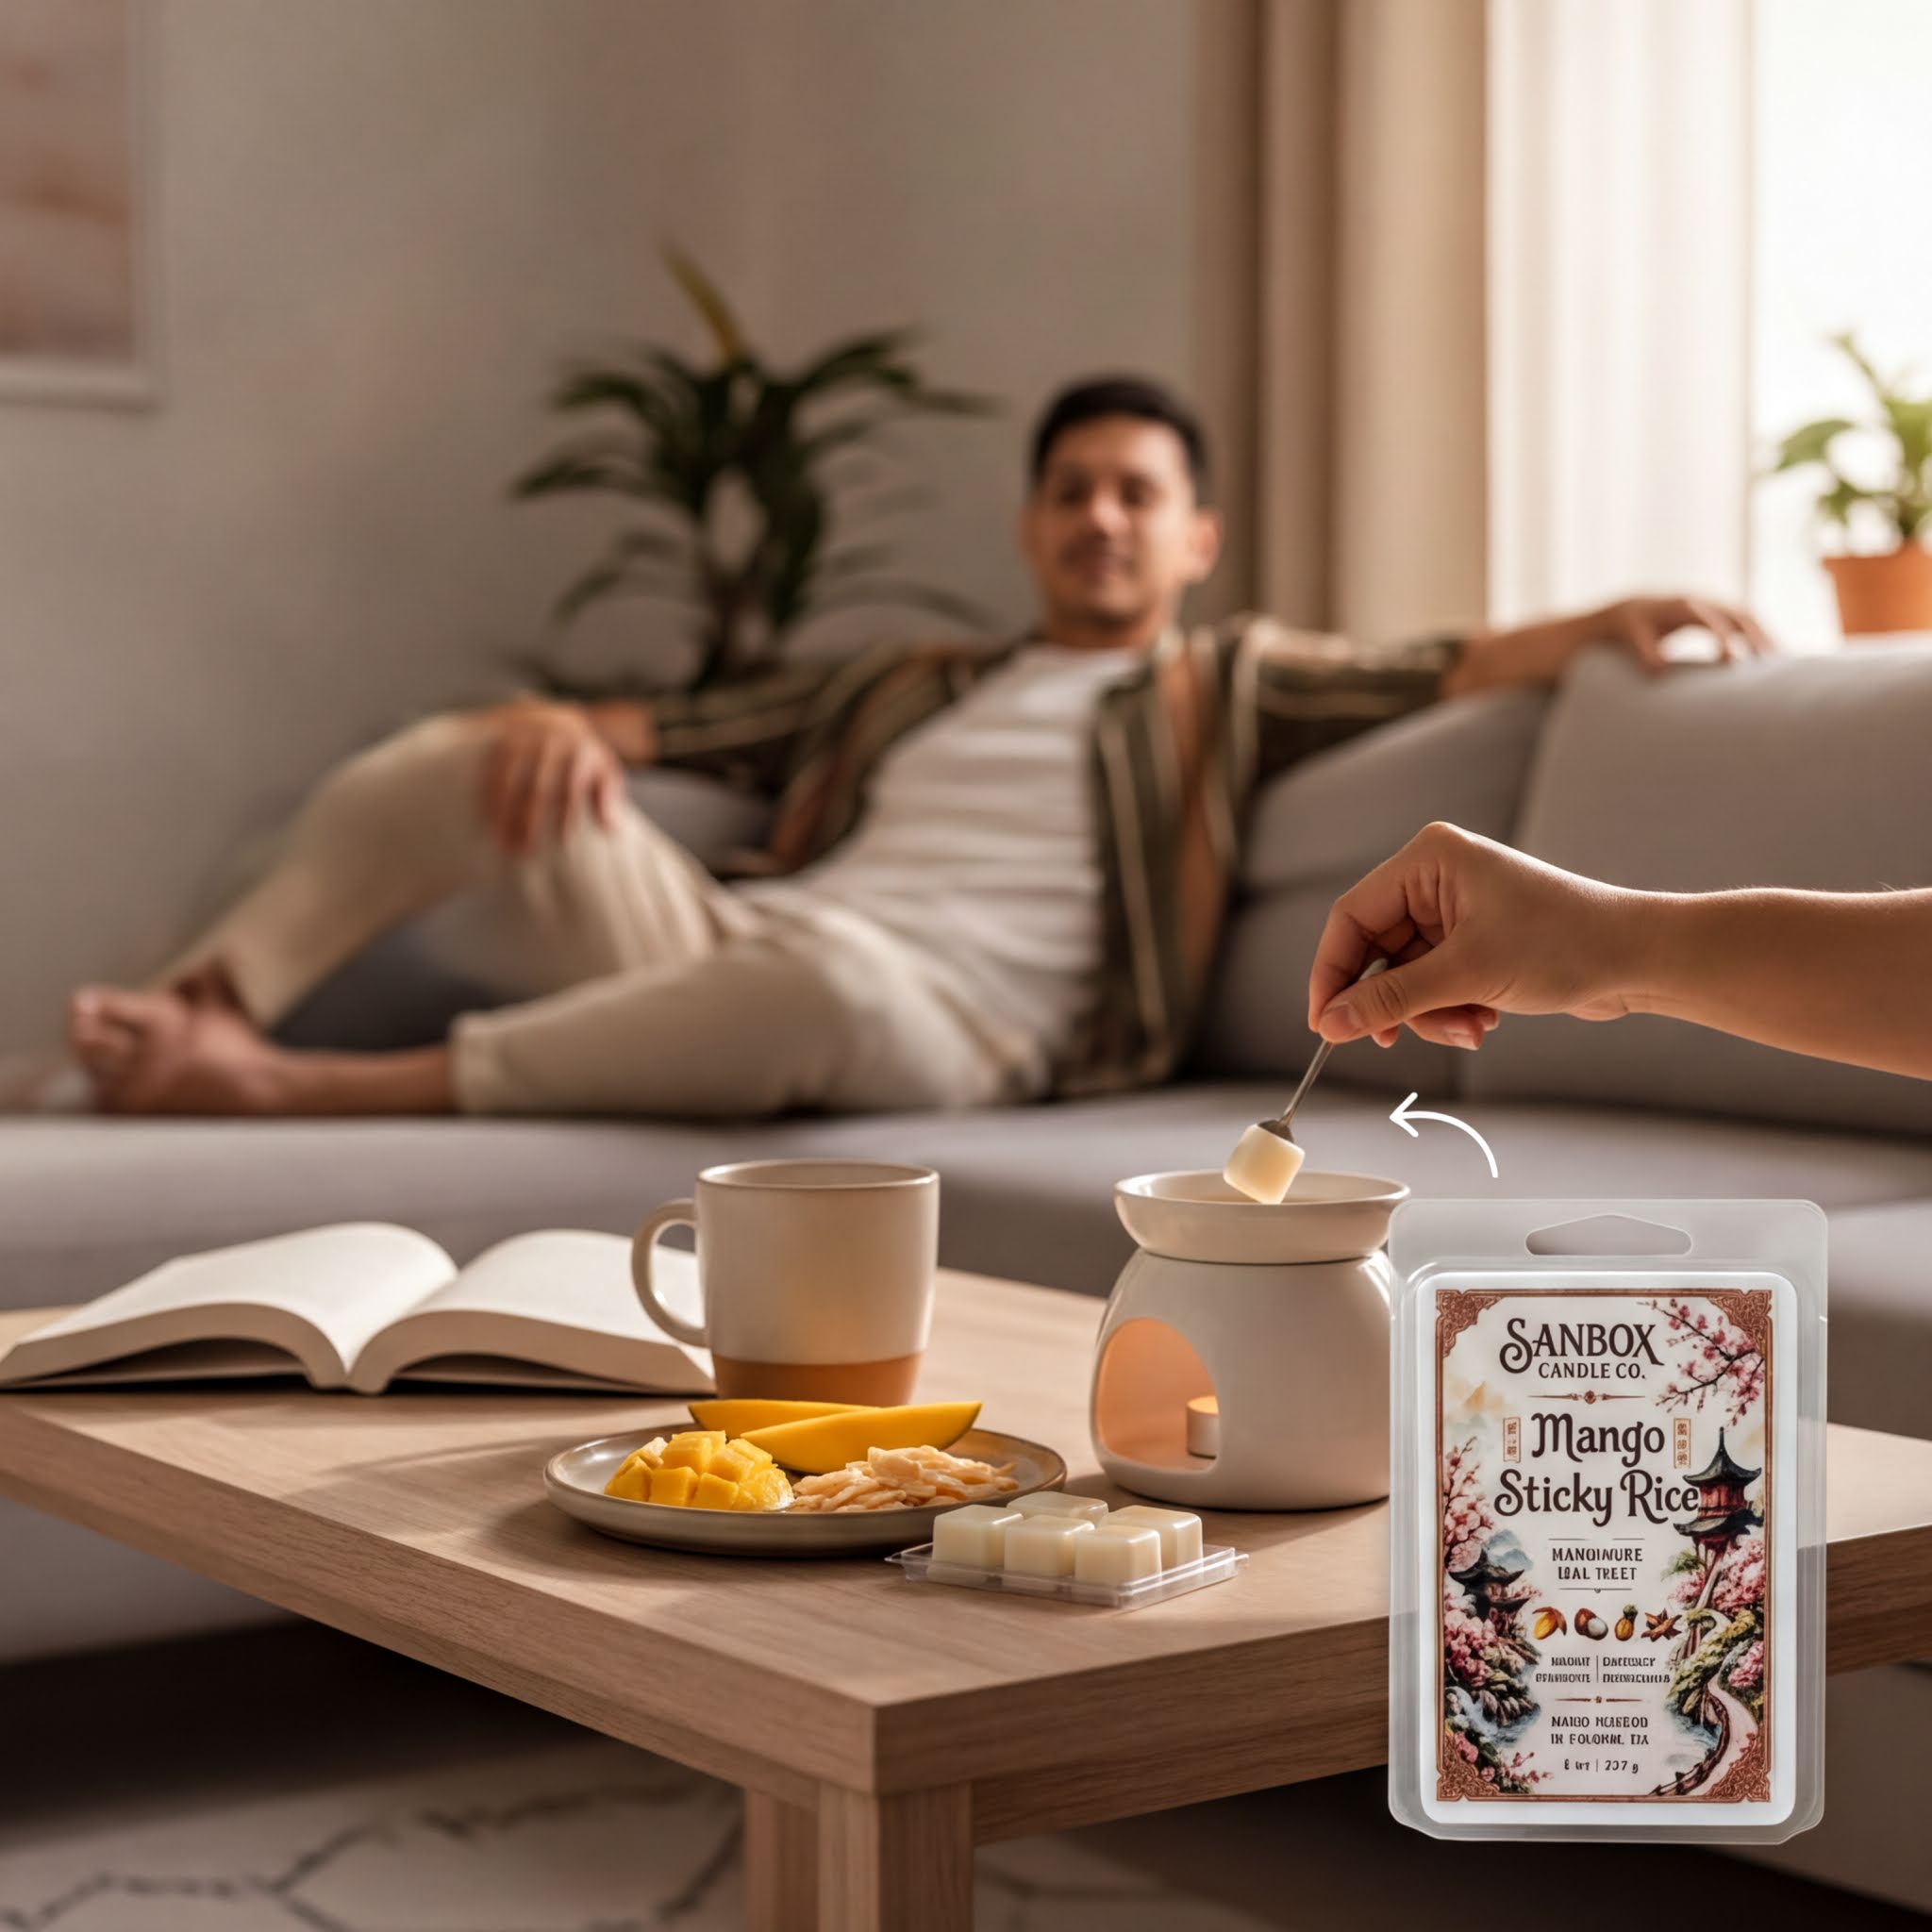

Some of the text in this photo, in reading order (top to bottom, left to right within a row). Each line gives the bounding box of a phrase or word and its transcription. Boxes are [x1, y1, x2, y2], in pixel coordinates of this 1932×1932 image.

[1499, 1317, 1665, 1374] SANBOX
[1538, 1362, 1646, 1380] CANDLE CO.
[1530, 1412, 1666, 1468] Mango
[1493, 1468, 1699, 1527] Sticky Rice
